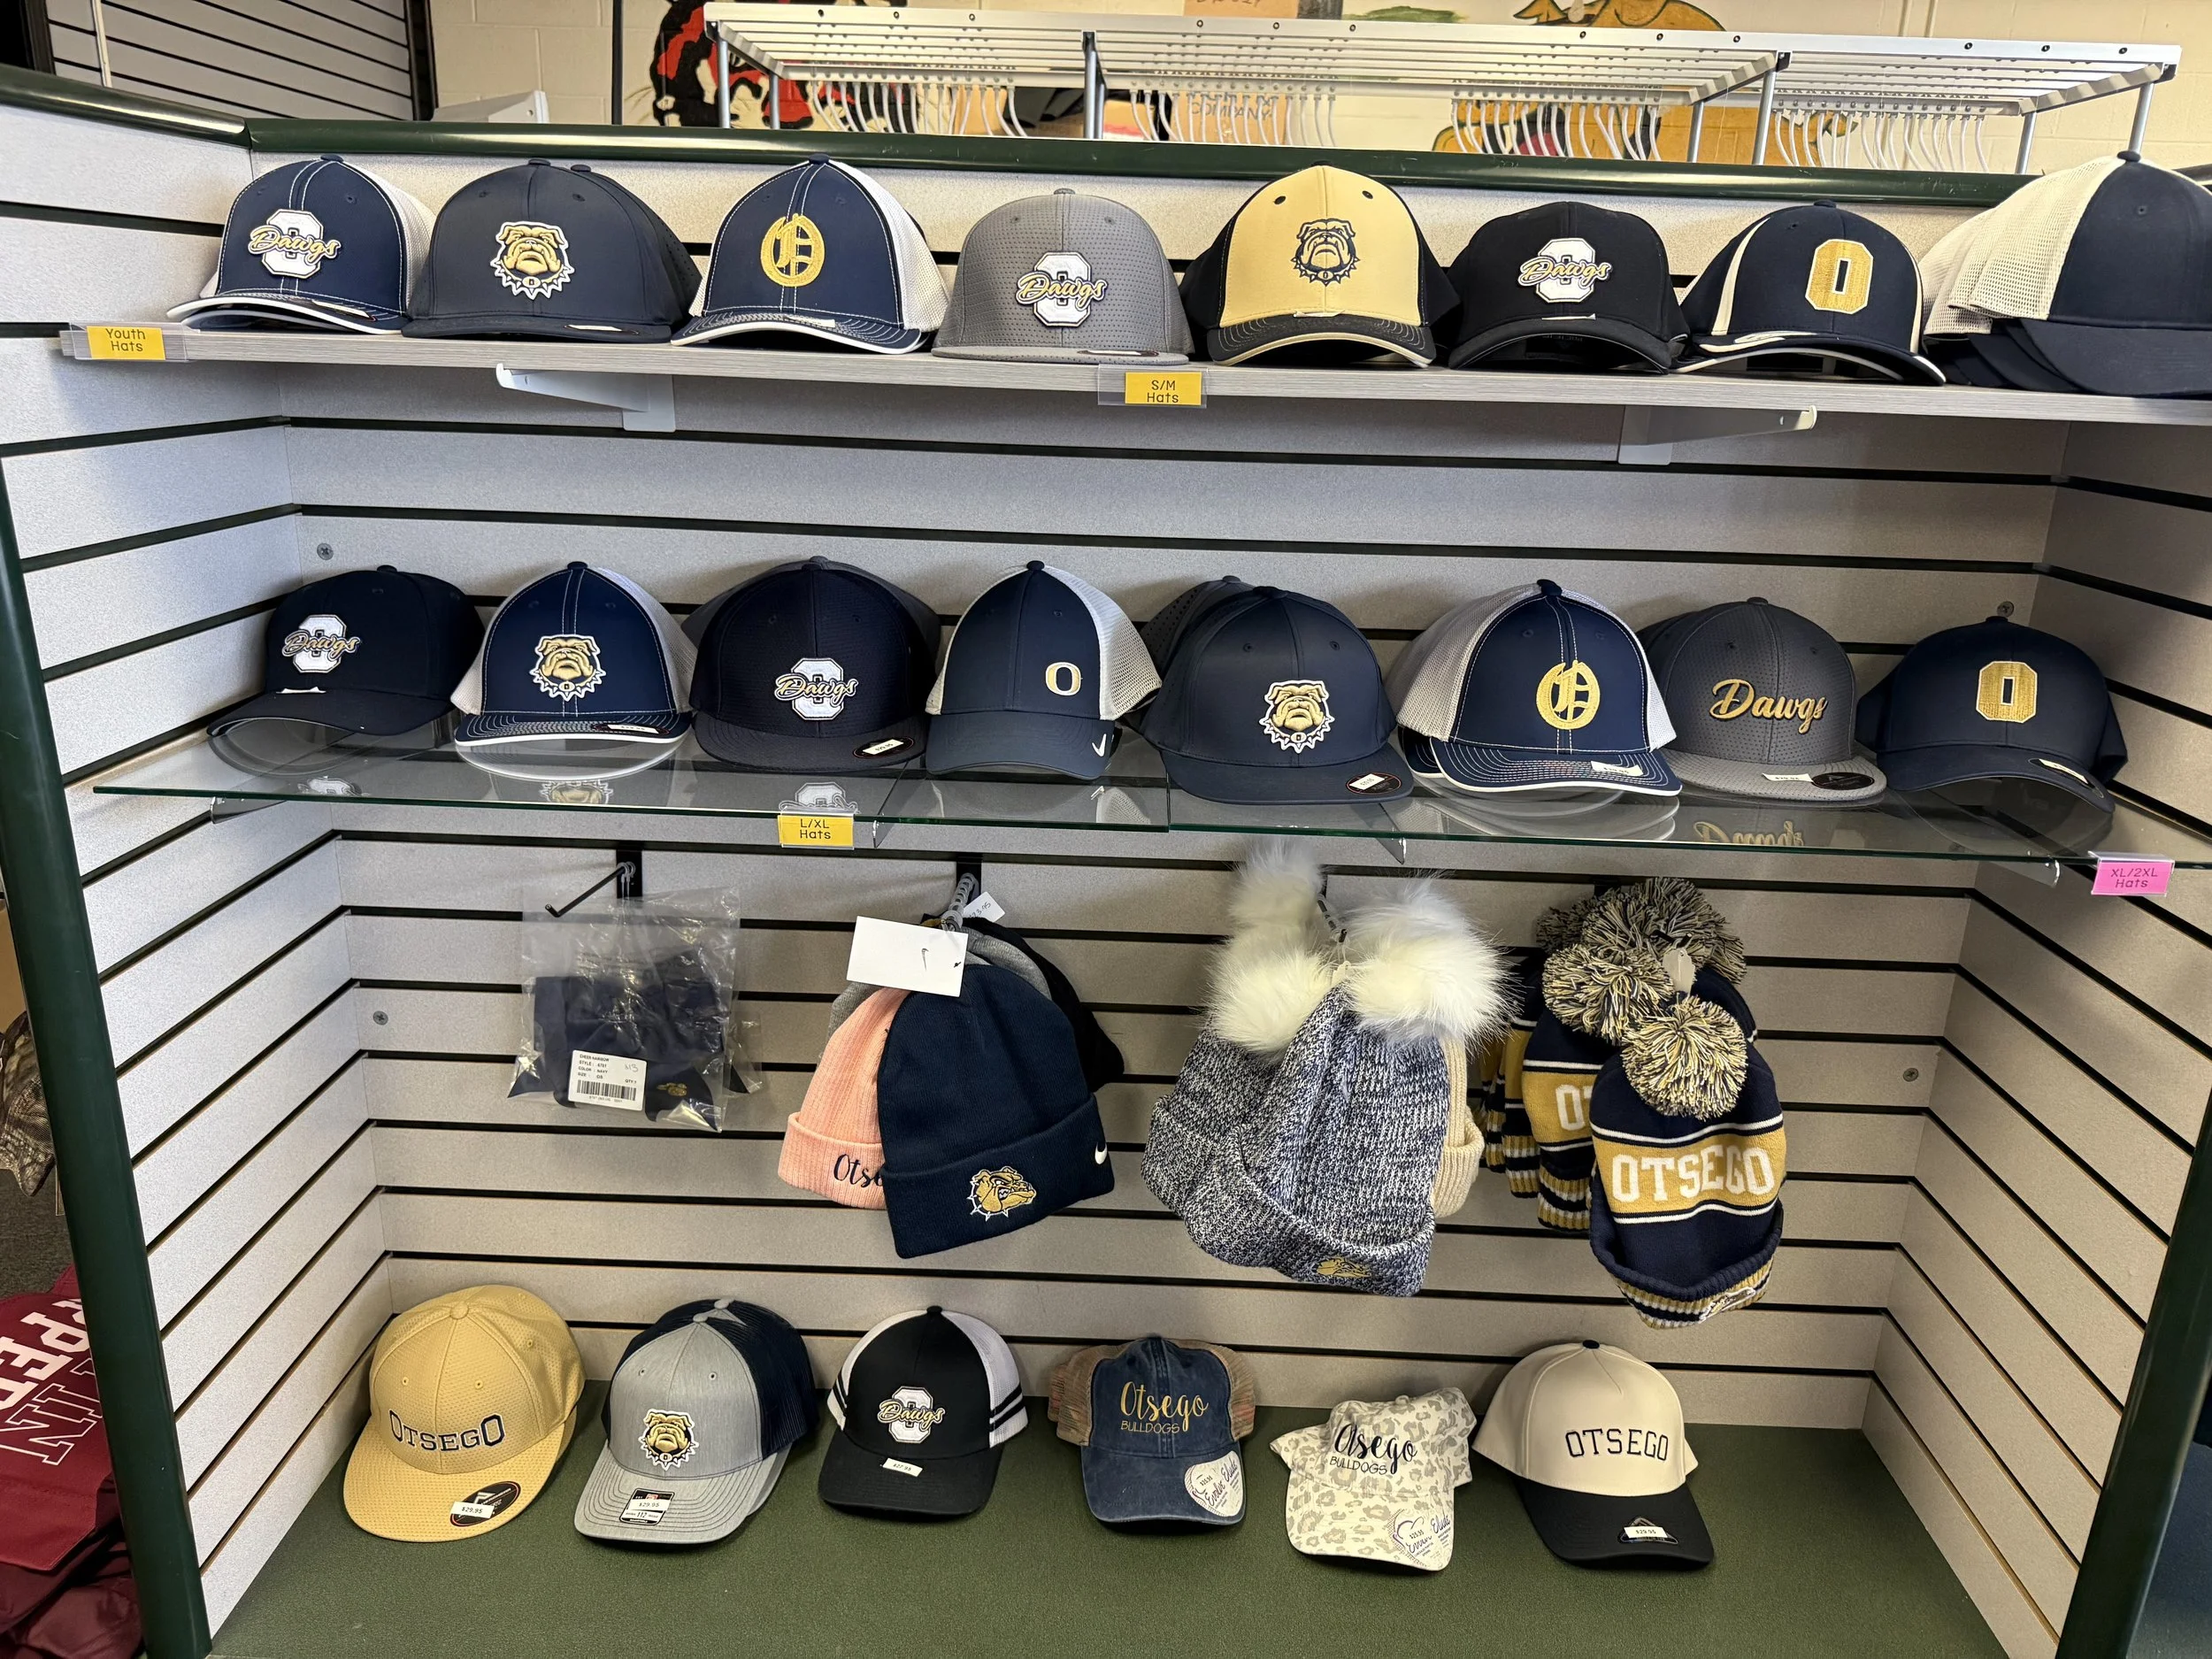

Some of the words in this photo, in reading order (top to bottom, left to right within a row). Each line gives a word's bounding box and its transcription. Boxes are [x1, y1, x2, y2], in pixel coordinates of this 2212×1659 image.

[249, 225, 342, 266] Dawgs
[1518, 257, 1612, 289] Dawgs
[1805, 238, 1874, 314] O
[1016, 271, 1108, 311] Dawgs
[105, 328, 146, 340] Youth
[111, 341, 143, 352] Hats
[1147, 392, 1179, 403] Hats
[1151, 380, 1176, 390] S/M
[282, 630, 361, 662] Dawgs
[774, 673, 859, 708] Dawgs
[1046, 662, 1081, 696] O
[1976, 661, 2038, 724] O
[1709, 679, 1828, 734] Dawgs
[800, 818, 830, 829] L/XL
[800, 830, 832, 840] Hats
[2111, 868, 2158, 878] XL/2XL
[2115, 879, 2148, 888] Hats
[1611, 1144, 1776, 1203] OTSEGO
[878, 1399, 946, 1432] Dawgs
[1120, 1381, 1209, 1432] Otsego
[389, 1409, 505, 1451] OTSEGO
[1121, 1420, 1180, 1433] BULLDOGS
[1565, 1428, 1669, 1461] OTSEGO
[1330, 1455, 1387, 1475] BULLDOGS
